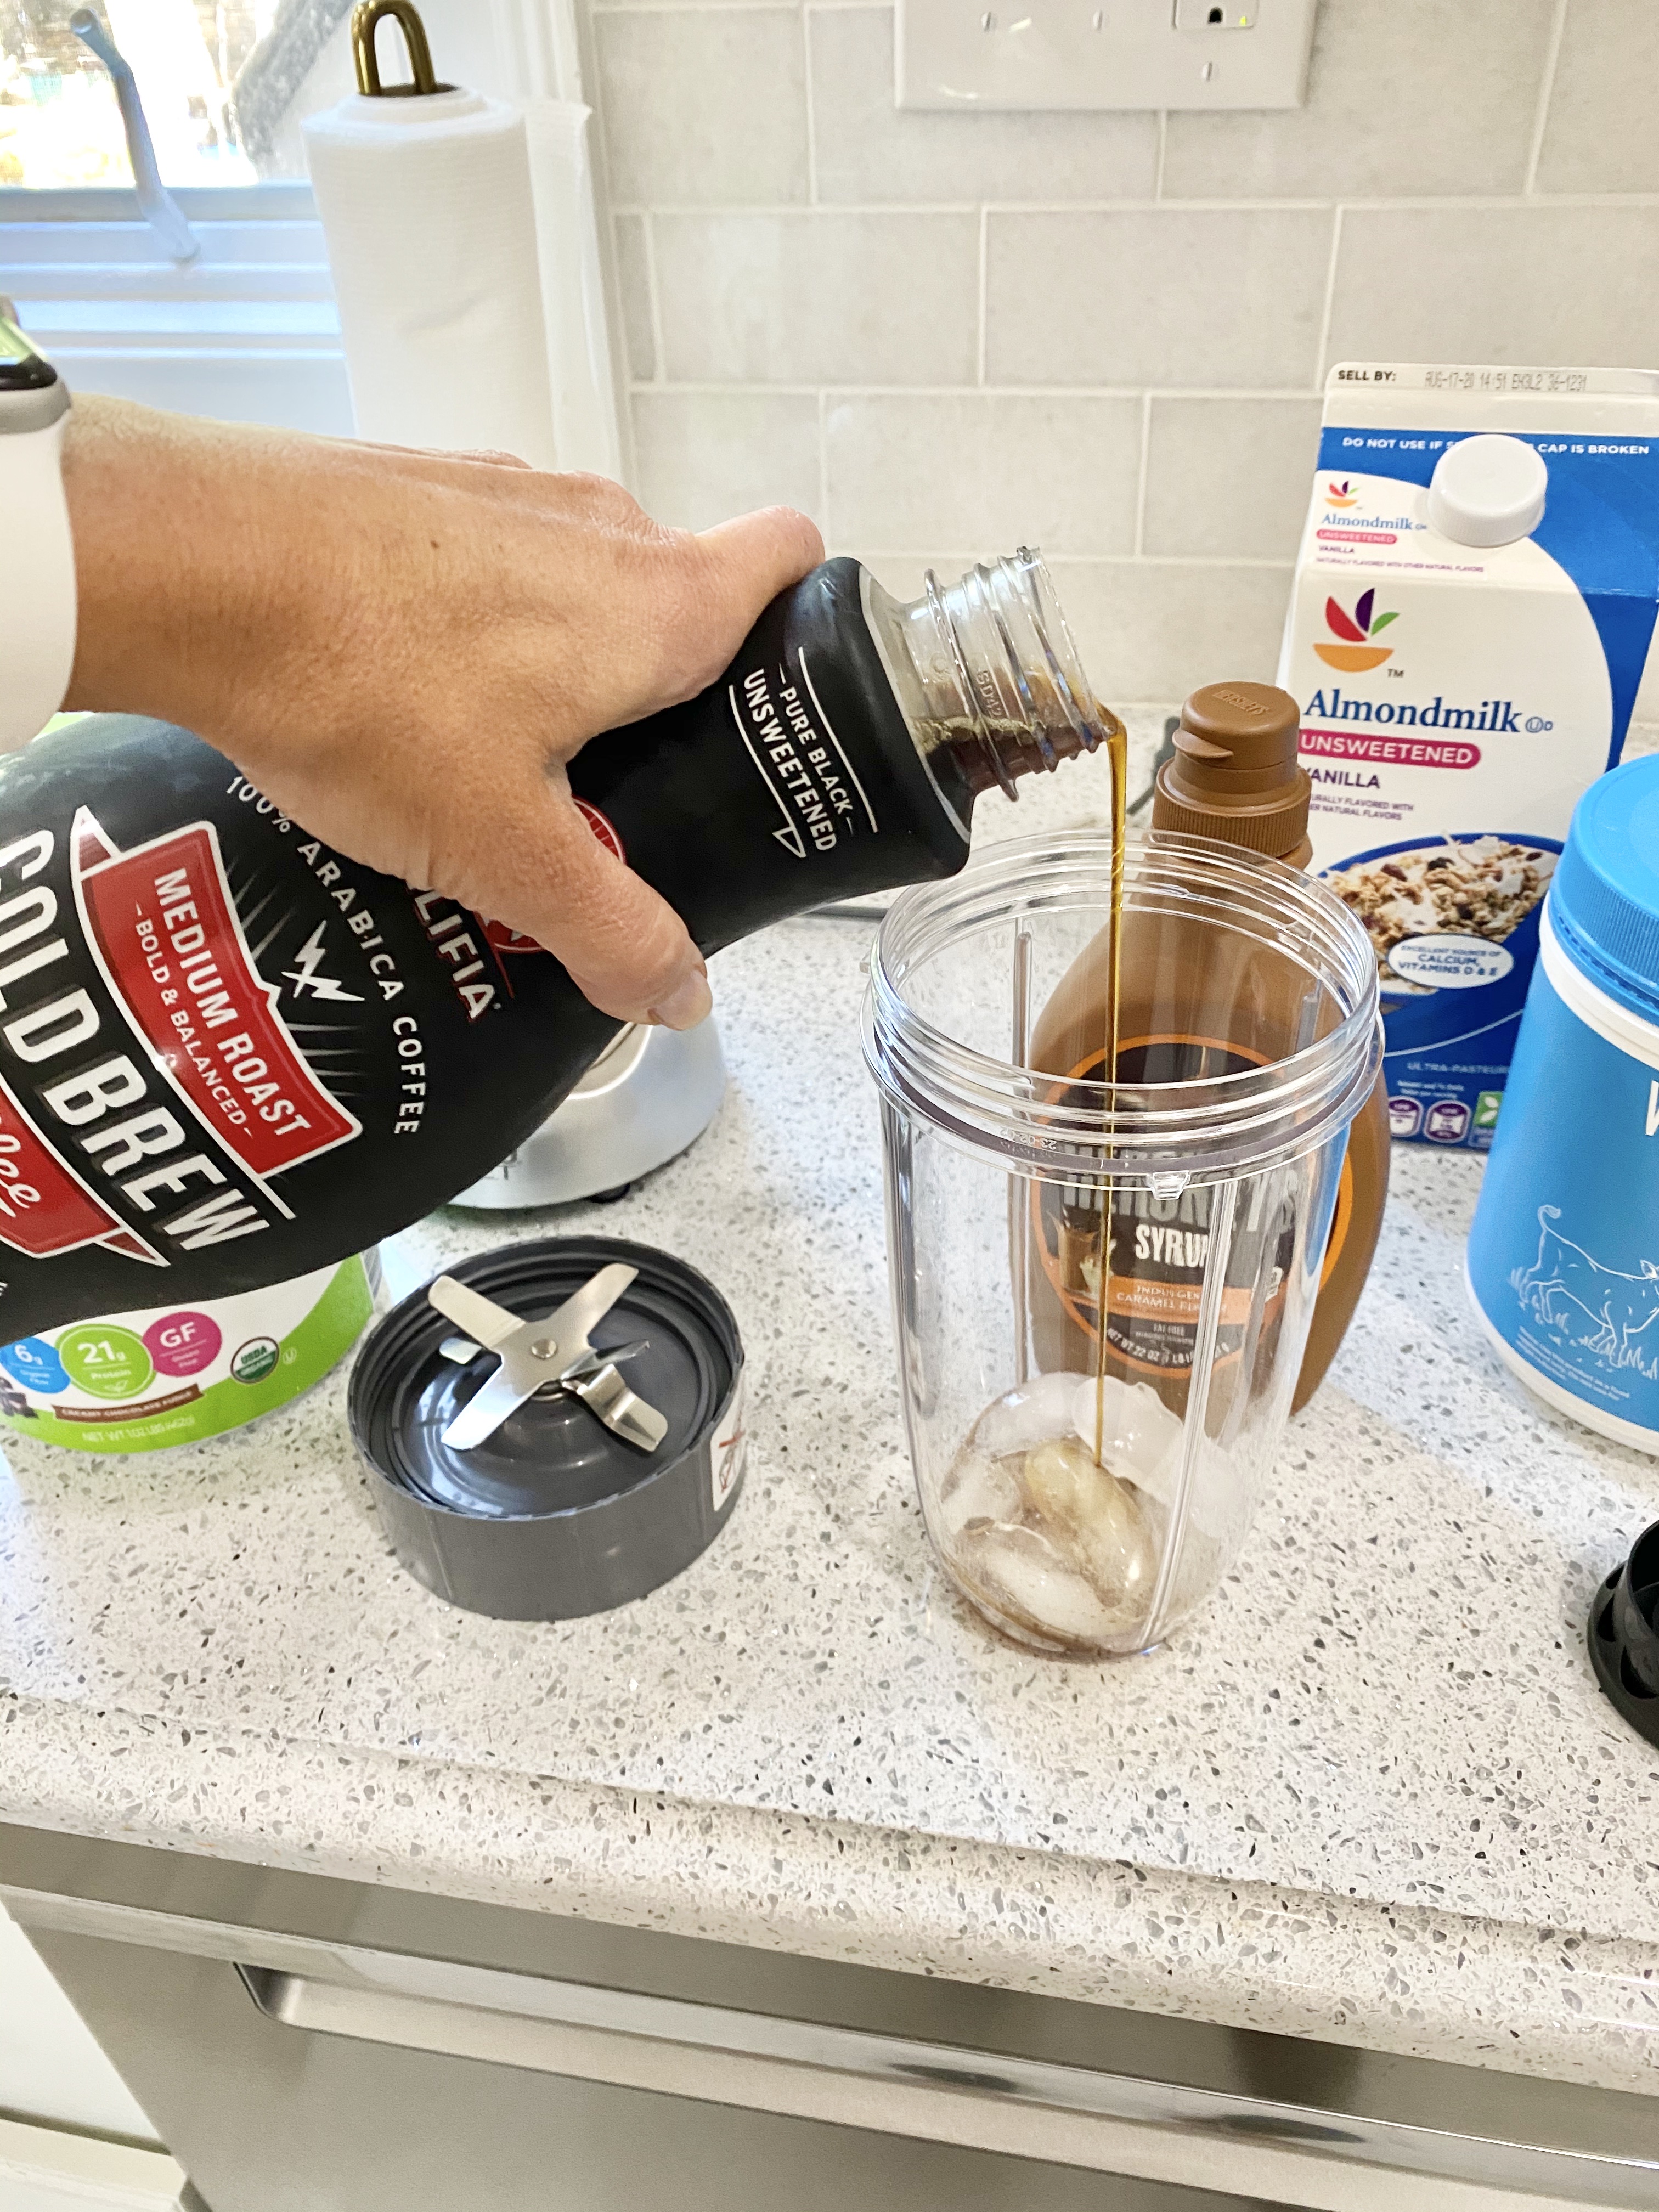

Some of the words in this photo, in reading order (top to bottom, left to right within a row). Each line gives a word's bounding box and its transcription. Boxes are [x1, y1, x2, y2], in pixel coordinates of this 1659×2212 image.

[1338, 370, 1370, 381] SELL
[1374, 370, 1397, 381] BY:
[1342, 437, 1364, 448] DO
[1367, 438, 1396, 449] NOT
[1399, 439, 1426, 450] USE
[1429, 440, 1443, 450] IF
[1537, 443, 1568, 453] CAP
[1570, 444, 1584, 454] IS
[1587, 445, 1650, 455] BROKEN
[1322, 513, 1413, 531] Almondmilk
[1302, 688, 1523, 733] Almondmilk
[743, 668, 837, 851] UNSWEETENED
[779, 686, 817, 746] PURE
[807, 747, 854, 815] BLACK
[1300, 734, 1474, 765] UNSWEETENED
[226, 776, 291, 833] 100%
[297, 841, 405, 1001] ARABICA
[393, 1016, 426, 1134] COFFEE
[414, 891, 495, 1019] LIFIA
[154, 867, 239, 1029] MEDIUM
[217, 1031, 312, 1136] ROAST
[136, 918, 170, 984] BOLD
[160, 988, 179, 1006] &
[170, 1009, 246, 1124] BALANCED
[42, 1053, 270, 1251] BREW
[77, 1340, 126, 1364] 21g
[159, 1321, 196, 1348] GF
[240, 1345, 267, 1365] USDA
